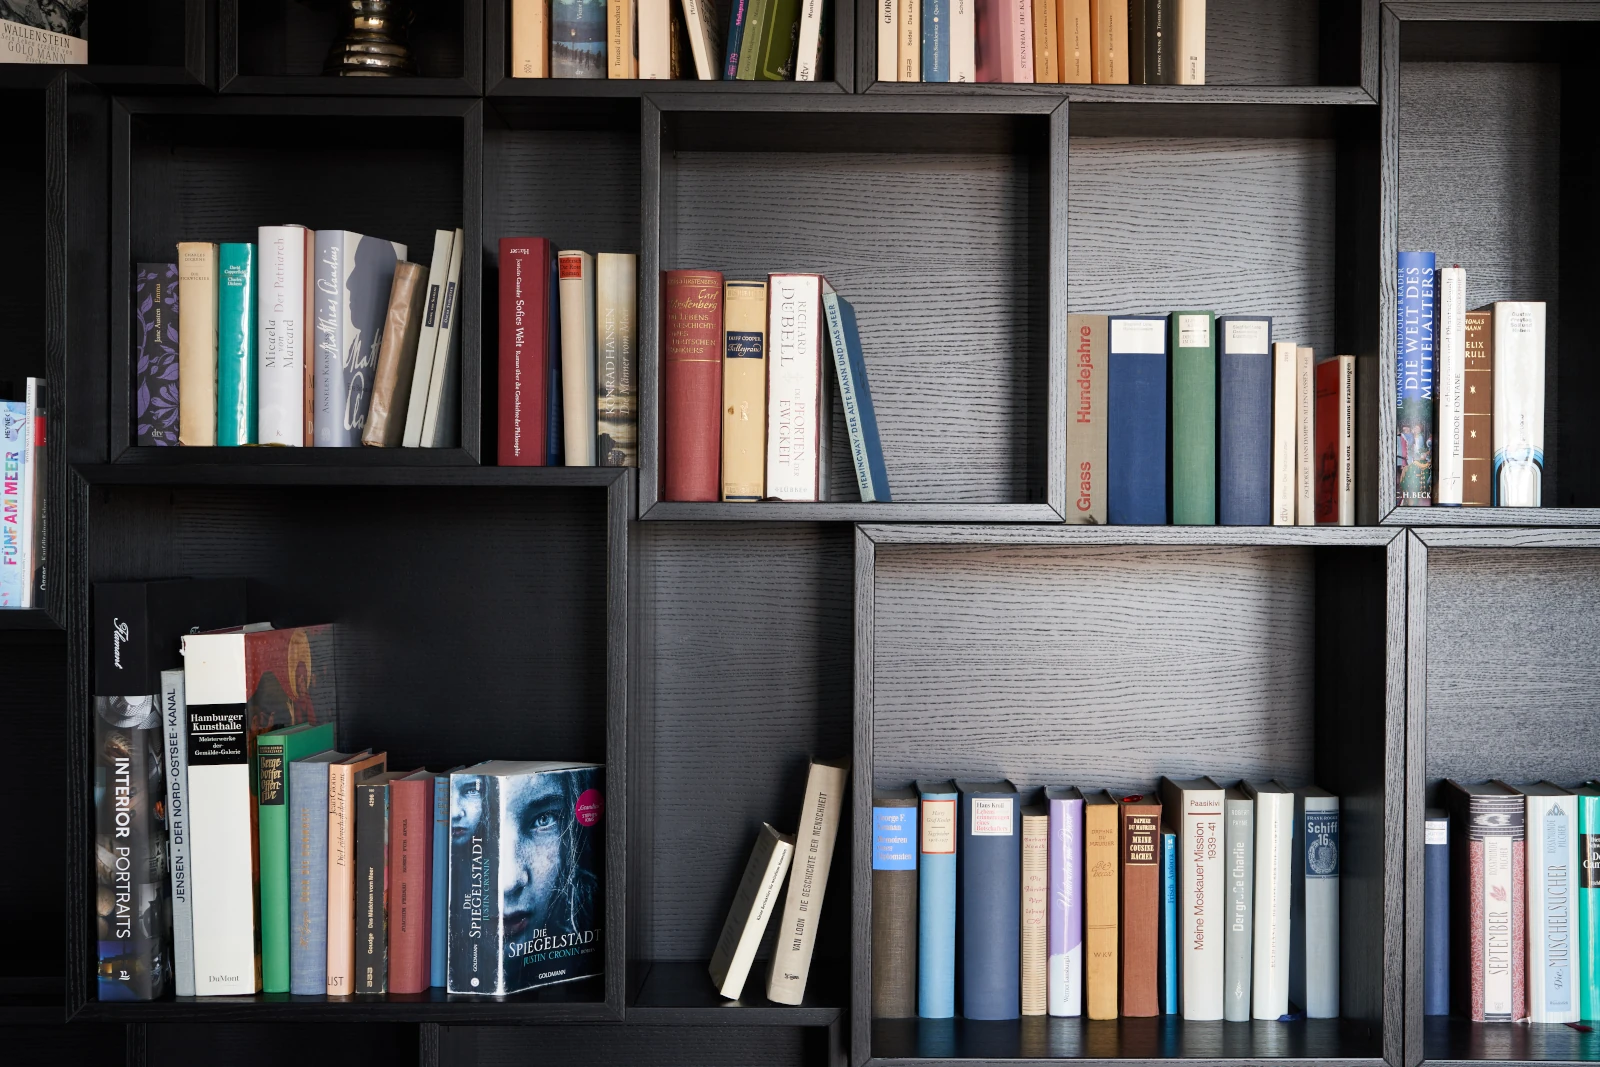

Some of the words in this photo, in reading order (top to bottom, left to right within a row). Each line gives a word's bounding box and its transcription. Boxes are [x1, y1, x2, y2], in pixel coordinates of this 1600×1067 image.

[614, 5, 622, 38] Lampedusa
[4, 23, 70, 48] WALLENSTEIN
[8, 42, 33, 56] GOLO
[37, 48, 66, 63] MANN
[273, 238, 284, 288] Patriarch
[317, 246, 339, 295] Claudius
[698, 288, 719, 300] Carl
[1397, 267, 1405, 297] RADER
[1406, 267, 1419, 299] DES
[273, 292, 284, 312] Der
[515, 299, 525, 325] Sofies
[619, 308, 630, 332] Meer
[797, 300, 807, 355] RICHARD
[828, 304, 838, 328] MEER
[154, 330, 163, 343] Jane
[316, 299, 339, 359] Matthias
[515, 327, 525, 347] Welt
[605, 307, 615, 359] HANSEN
[833, 329, 842, 346] DAS
[1405, 305, 1419, 354] WELT
[1420, 267, 1433, 400] MITTELALTERS
[265, 319, 276, 368] Micaela
[283, 320, 294, 368] Marcard
[622, 335, 630, 354] vom
[836, 347, 846, 366] UND
[619, 358, 630, 395] Männer
[840, 368, 851, 394] MANN
[1076, 325, 1093, 423] Hundejahre
[1405, 360, 1418, 390] DIE
[322, 376, 330, 414] ANNELEN
[605, 361, 615, 414] KONRAD
[619, 398, 630, 414] Die
[845, 396, 855, 415] ALTE
[793, 402, 805, 461] PFORTEN
[849, 416, 858, 434] DER
[1303, 416, 1309, 424] IN
[513, 427, 521, 457] Philosophie
[778, 400, 791, 467] EWIGKEIT
[4, 451, 19, 495] MEER
[852, 438, 869, 489] HEMINGWAY
[1076, 461, 1091, 512] Grass
[4, 499, 18, 524] AM
[1280, 508, 1288, 522] dtv
[1, 525, 18, 565] FÜNF
[113, 617, 129, 670] Flamant
[190, 713, 244, 723] Hamburger
[192, 721, 242, 731] Kunsthalle
[167, 688, 182, 817] NORD-OSTSEE-KANAL
[194, 748, 241, 756] Gemälde-Galerie
[115, 757, 130, 838] INTERIOR
[329, 798, 337, 816] Jean
[1190, 799, 1220, 807] Paasikivi
[812, 791, 828, 837] MENSCHHEIT
[876, 814, 899, 823] George
[174, 821, 183, 845] DER
[1132, 836, 1152, 844] MEINE
[1307, 821, 1338, 834] Schiff
[1317, 833, 1329, 846] 16
[809, 839, 819, 853] DER
[1129, 844, 1154, 852] COUSINE
[1193, 822, 1204, 862] Mission
[876, 853, 912, 861] Diplomaten
[1232, 842, 1244, 878] Charlie
[1488, 841, 1498, 876] ROSAMUNDE
[1499, 847, 1508, 869] PILCHER
[175, 855, 185, 903] JENSEN
[469, 835, 483, 939] SPIEGELSTADT
[801, 855, 817, 898] GESCHICHTE
[115, 846, 131, 939] PORTRAITS
[462, 893, 472, 910] DIE
[1167, 886, 1175, 904] Frisch
[1193, 863, 1204, 916] Moskauer
[483, 894, 491, 921] JUSTIN
[799, 900, 809, 912] DIE
[1547, 864, 1568, 968] MUSCHELSUCHER
[533, 928, 548, 939] DIE
[794, 918, 805, 936] LOON
[1193, 918, 1204, 951] Meine
[1232, 912, 1244, 932] Der
[367, 932, 375, 955] Goudge
[508, 928, 604, 958] SPIEGELSTADT
[792, 938, 802, 952] VAN
[1488, 911, 1509, 975] SEPTEMBER
[523, 952, 546, 967] JUSTIN
[548, 946, 581, 960] CRONIN
[1063, 955, 1071, 983] Lansburgh
[208, 974, 239, 983] DuMont
[327, 976, 344, 986] LIST
[538, 968, 566, 980] GOLDMANN
[1554, 968, 1564, 991] Die
